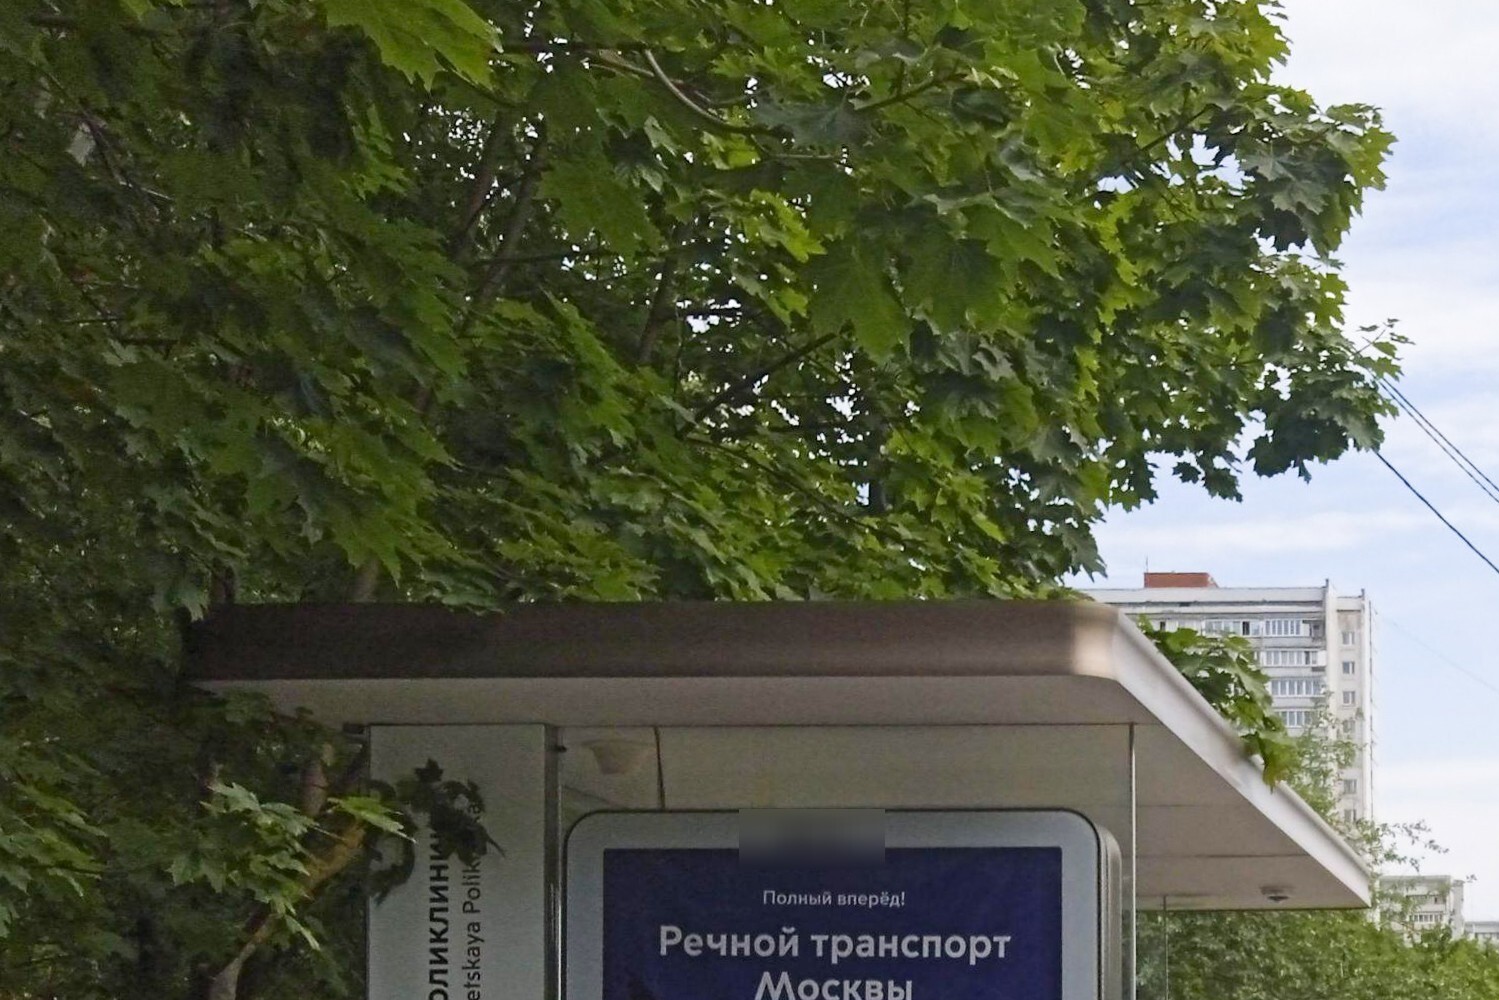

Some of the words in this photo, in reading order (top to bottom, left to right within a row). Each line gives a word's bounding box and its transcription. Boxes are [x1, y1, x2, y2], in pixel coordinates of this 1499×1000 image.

[763, 890, 832, 906] Полный
[837, 891, 905, 908] вперёд!
[660, 925, 799, 957] Речной
[810, 934, 1011, 965] транспорт
